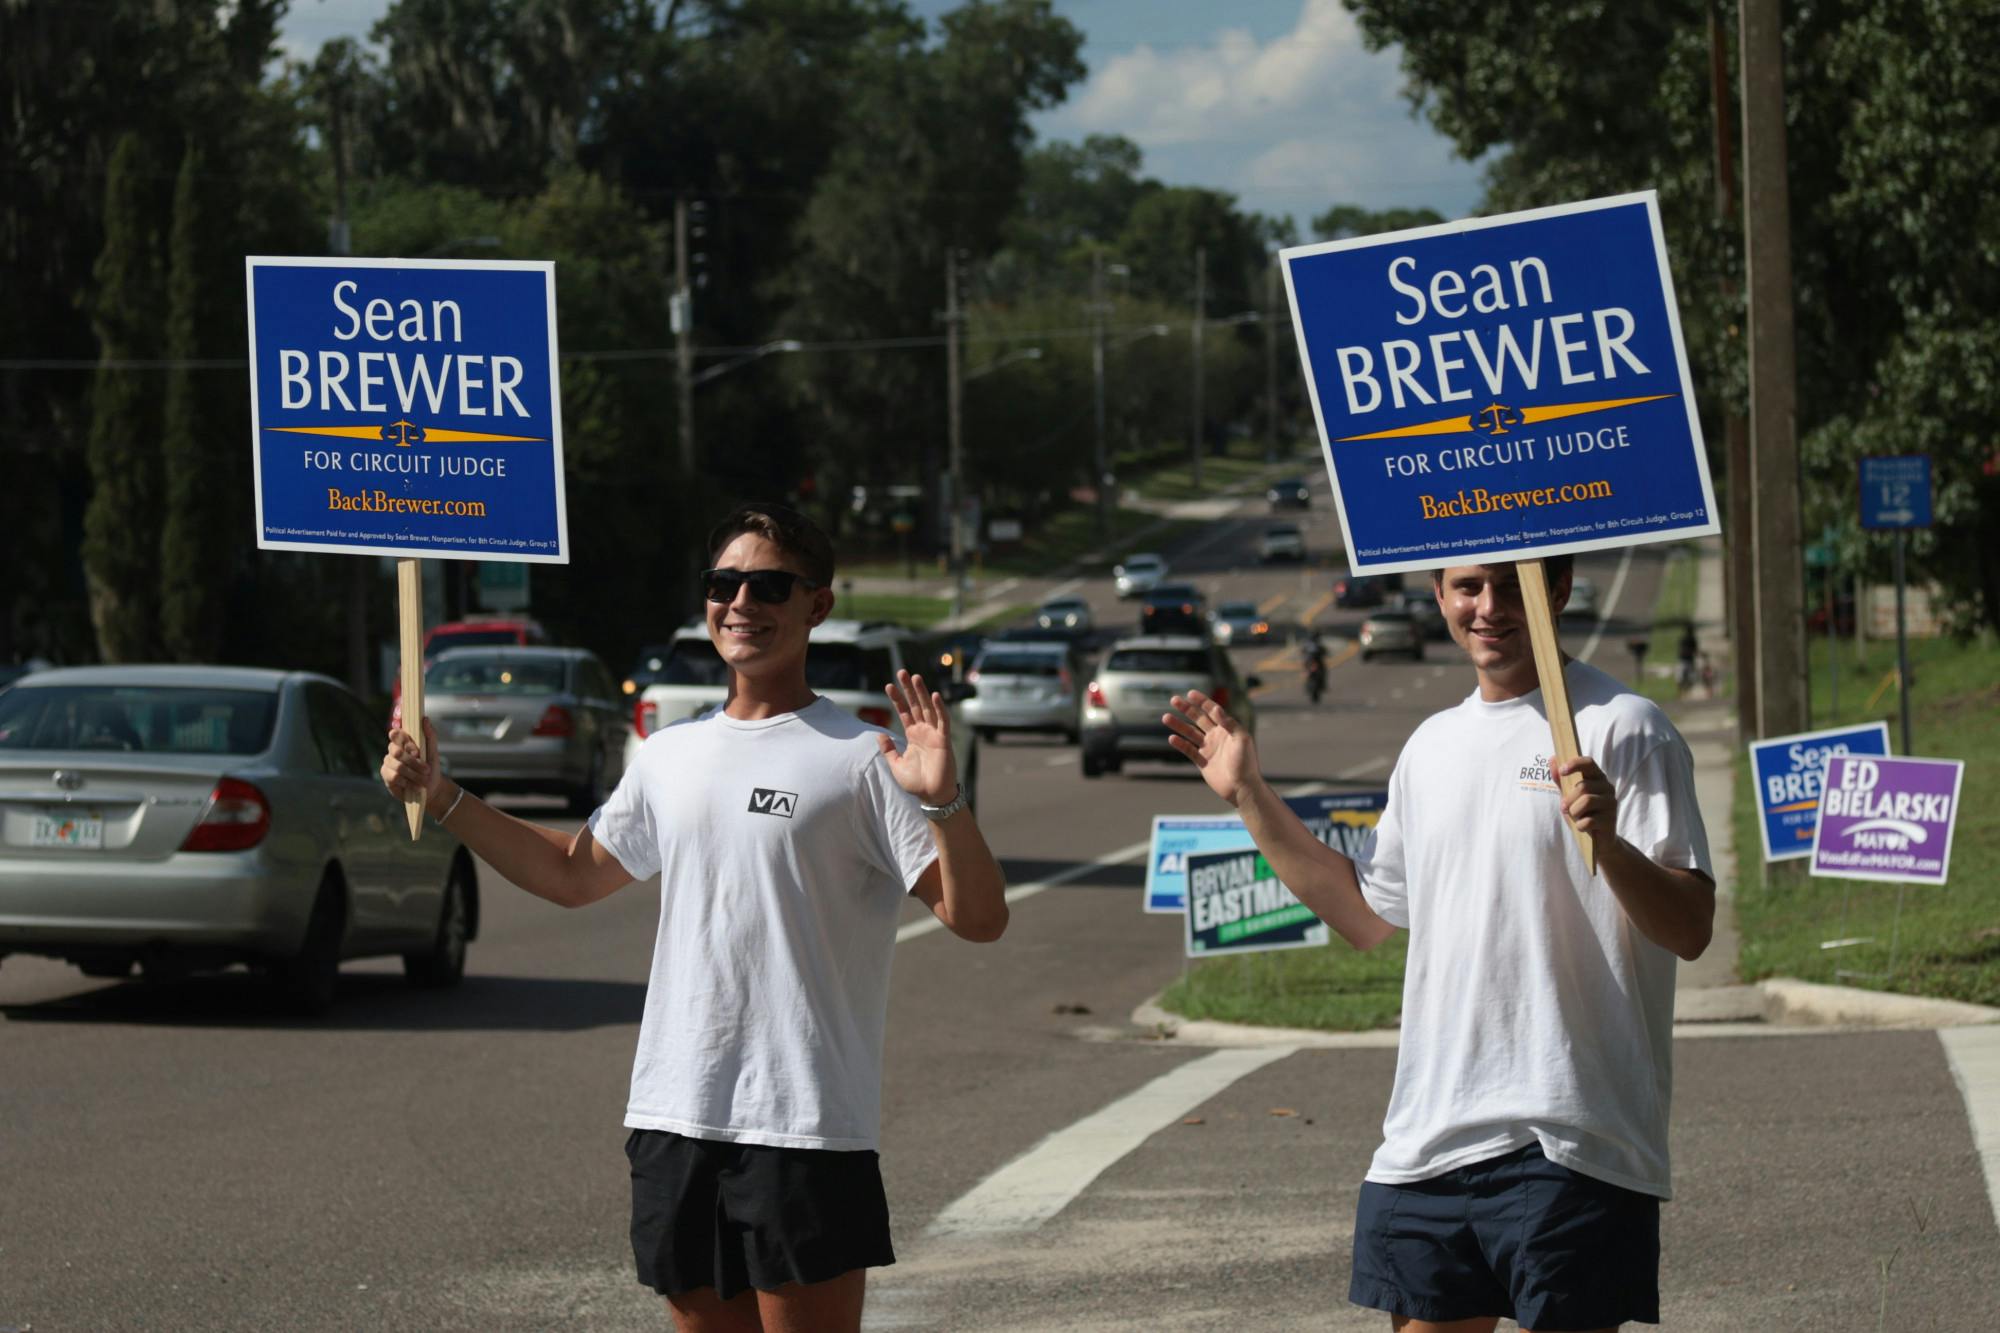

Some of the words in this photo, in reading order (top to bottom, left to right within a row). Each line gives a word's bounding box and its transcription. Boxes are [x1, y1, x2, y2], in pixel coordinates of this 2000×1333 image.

[333, 280, 462, 342] Sean
[1388, 255, 1553, 327] Sean
[1335, 306, 1652, 415] BREWER
[280, 349, 532, 418] BREWER
[304, 450, 343, 471] FOR
[350, 452, 432, 474] CIRCUIT
[439, 456, 506, 478] JUDGE
[1384, 452, 1432, 478] FOR
[1438, 439, 1536, 472] CIRCUIT
[1546, 426, 1631, 462] JUDGE
[327, 488, 486, 516] BackBrewer.com
[1418, 480, 1613, 520] BackBrewer.com
[265, 526, 286, 535] Political
[287, 528, 325, 537] Advertisement
[348, 530, 358, 538] and
[359, 532, 386, 541] Approved
[387, 532, 394, 541] by
[395, 533, 409, 541] Sean
[468, 536, 477, 544] for
[489, 538, 507, 546] Circuit
[529, 540, 548, 548] Group
[1358, 547, 1381, 558] Political
[1382, 544, 1425, 555] Advertisement
[1426, 542, 1440, 551] Paid
[1440, 541, 1450, 549] for
[1451, 540, 1463, 548] and
[1464, 536, 1495, 548] Approved
[1496, 535, 1504, 545] by
[1596, 522, 1605, 530] for
[1607, 520, 1620, 529] 8th
[1620, 517, 1644, 527] Circuit
[1670, 510, 1693, 521] Group
[1695, 508, 1704, 517] 12
[1520, 766, 1552, 781] BREW
[1767, 769, 1824, 804] BRE
[1841, 759, 1880, 791] ED
[1825, 788, 1950, 823] BIELARSKI
[1192, 855, 1254, 898] BRYAN
[1194, 877, 1302, 932] EASTMA
